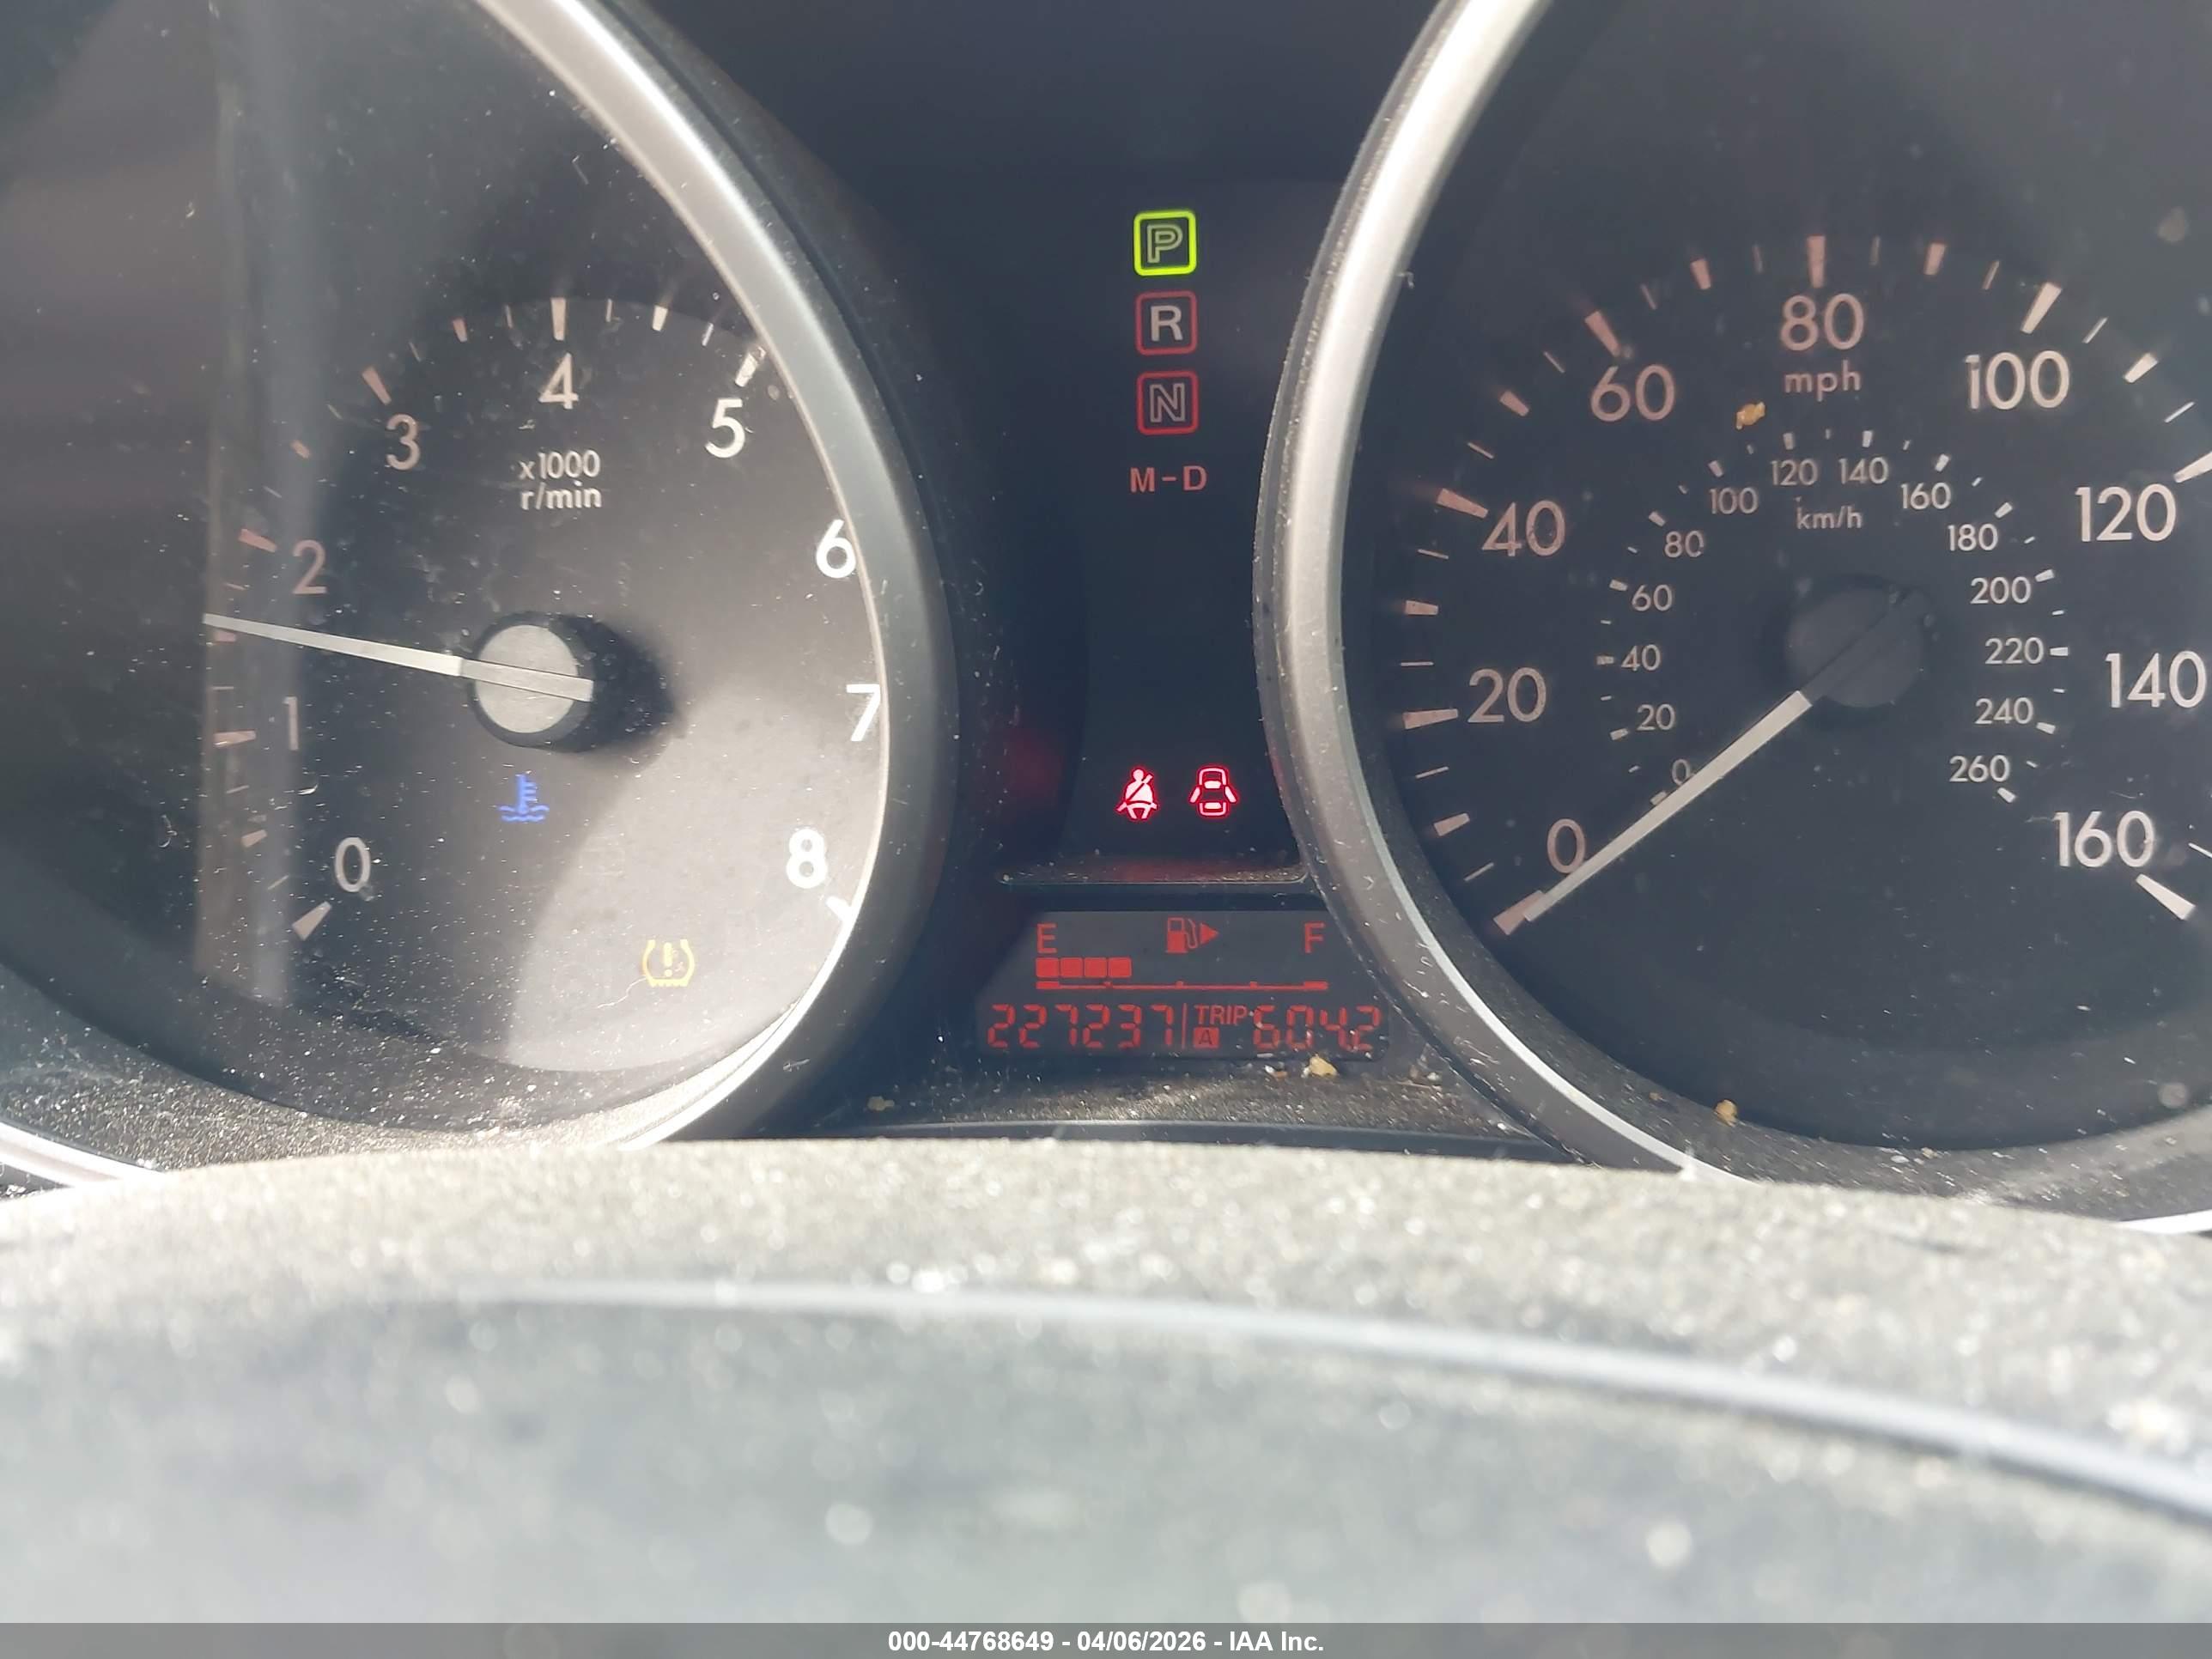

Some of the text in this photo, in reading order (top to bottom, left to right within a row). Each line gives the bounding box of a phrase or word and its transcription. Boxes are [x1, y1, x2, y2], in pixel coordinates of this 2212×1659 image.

[1146, 223, 1183, 264] P
[1150, 304, 1183, 342] R
[1780, 294, 1864, 352] 80
[539, 353, 578, 409] 4
[1590, 364, 1675, 423] 60
[1784, 362, 1862, 401] mph
[1965, 350, 2070, 411] 100
[1149, 382, 1186, 423] N
[386, 412, 421, 471] 3
[705, 398, 745, 459] 5
[520, 451, 601, 479] x1000
[1771, 459, 1819, 487] 120
[1839, 456, 1889, 485] 140
[520, 483, 602, 510] r/min
[1709, 487, 1758, 516] 100
[1901, 482, 1951, 511] 160
[2075, 485, 2178, 544] 120
[1483, 499, 1566, 559] 40
[1796, 503, 1863, 532] km/h
[816, 520, 856, 578] 6
[1664, 531, 1704, 558] 80
[1948, 524, 1998, 552] 180
[292, 539, 327, 594] 2
[1632, 584, 1674, 612] 60
[1970, 576, 2031, 605] 200
[1620, 644, 1662, 672] 40
[1984, 637, 2045, 665] 220
[1467, 667, 1547, 724] 20
[2104, 651, 2207, 709] 140
[285, 696, 300, 752] 1
[846, 684, 881, 741] 7
[1635, 704, 1675, 732] 20
[1975, 697, 2034, 726] 240
[1671, 758, 1691, 787] 0
[1949, 755, 2010, 784] 260
[787, 829, 828, 888] 8
[1547, 818, 1588, 875] 0
[2052, 810, 2155, 868] 160
[335, 837, 371, 892] 0
[1037, 923, 1057, 954] E
[1304, 922, 1326, 953] F
[988, 1004, 1174, 1048] 227237
[1194, 1005, 1247, 1025] TRIP
